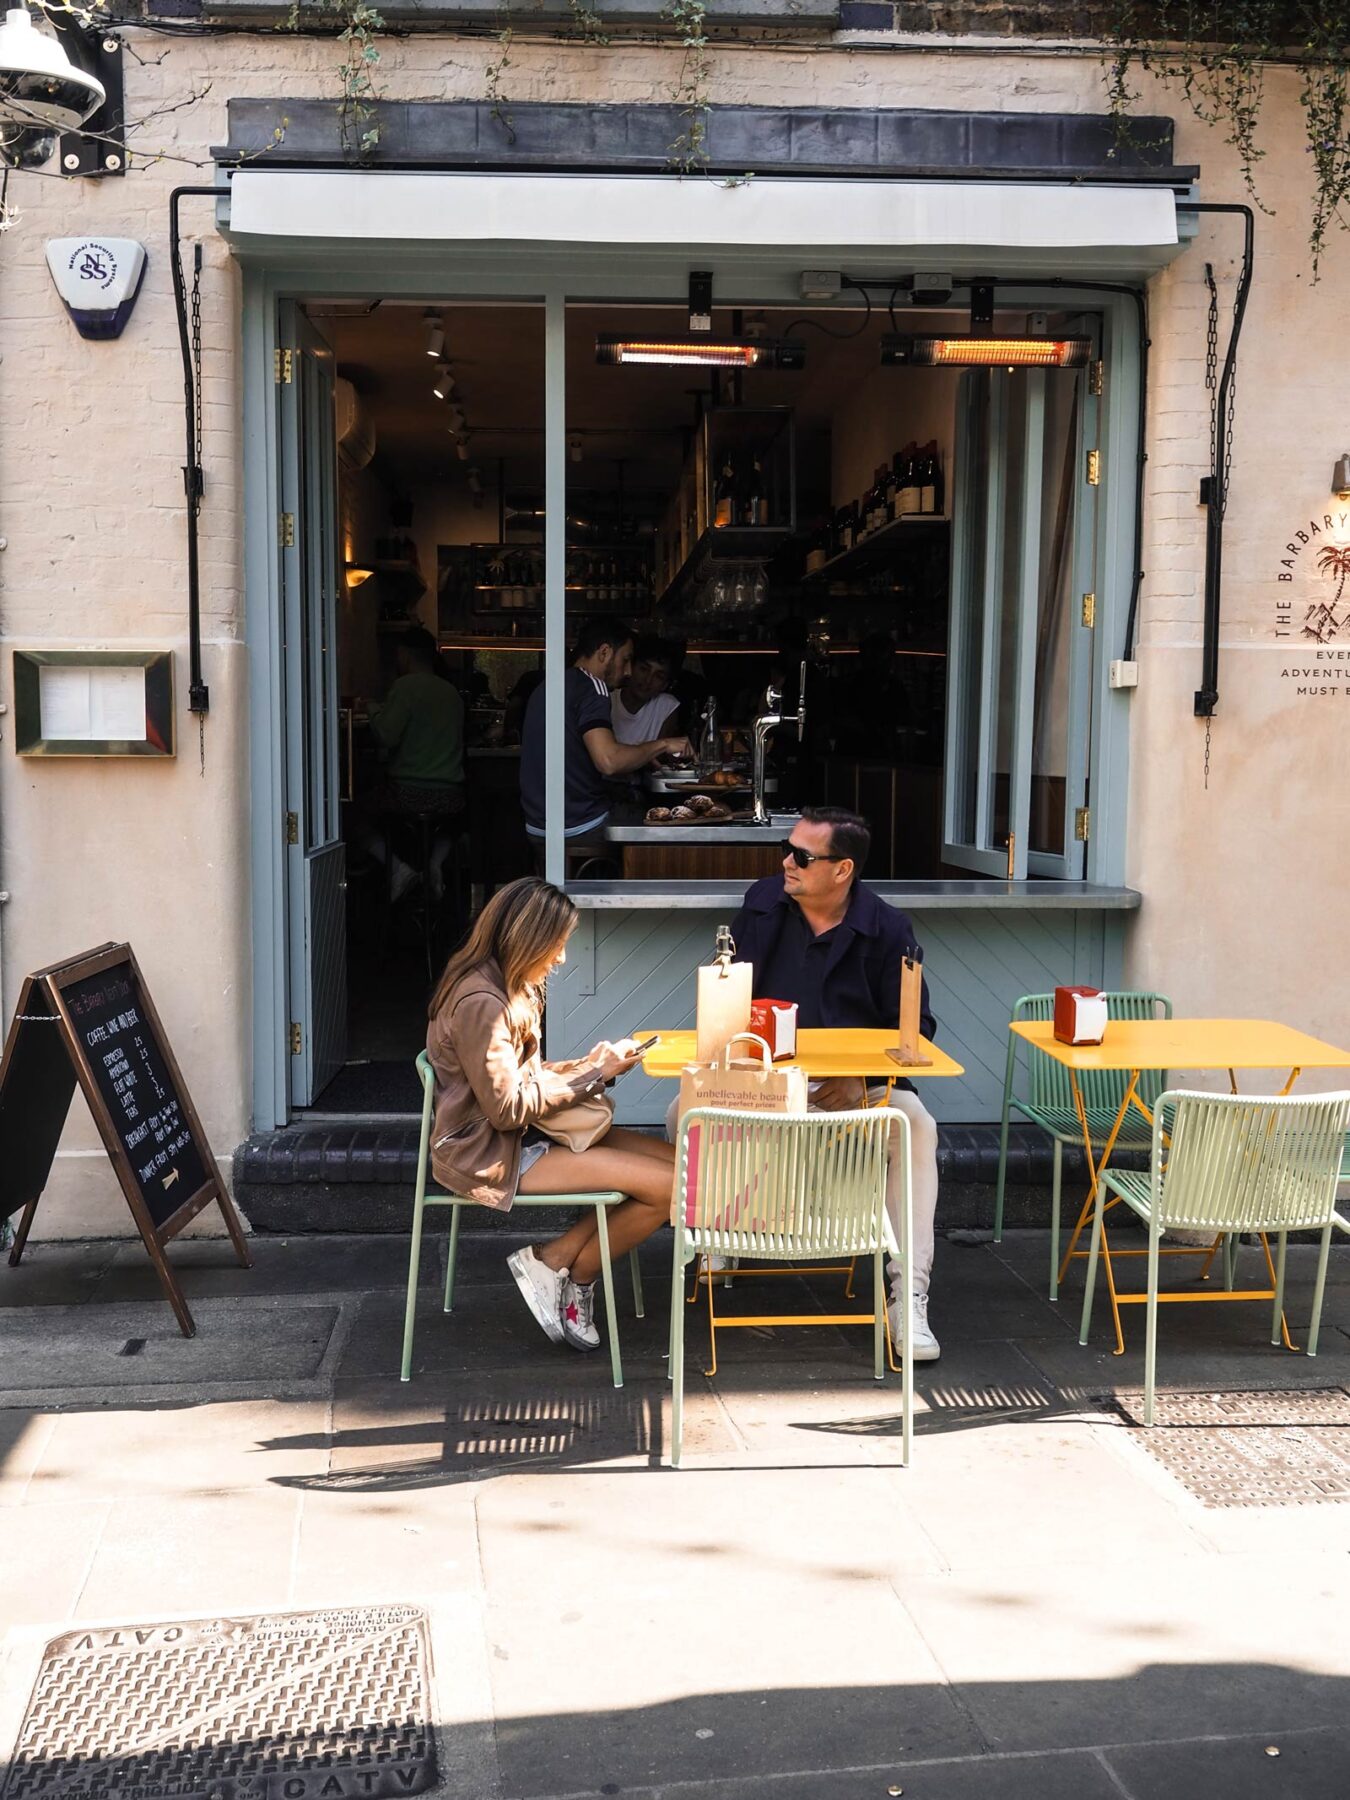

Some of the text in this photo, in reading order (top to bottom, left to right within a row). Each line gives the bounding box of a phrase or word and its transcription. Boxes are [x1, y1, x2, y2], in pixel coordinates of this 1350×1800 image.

[68, 243, 118, 290] National Security Systems
[1275, 513, 1348, 637] THE BARBARY
[1316, 651, 1350, 660] EVE
[1296, 687, 1338, 696] MUST
[696, 1089, 758, 1100] unbelievable
[74, 1626, 183, 1650] CATV
[284, 1768, 418, 1798] CATV
